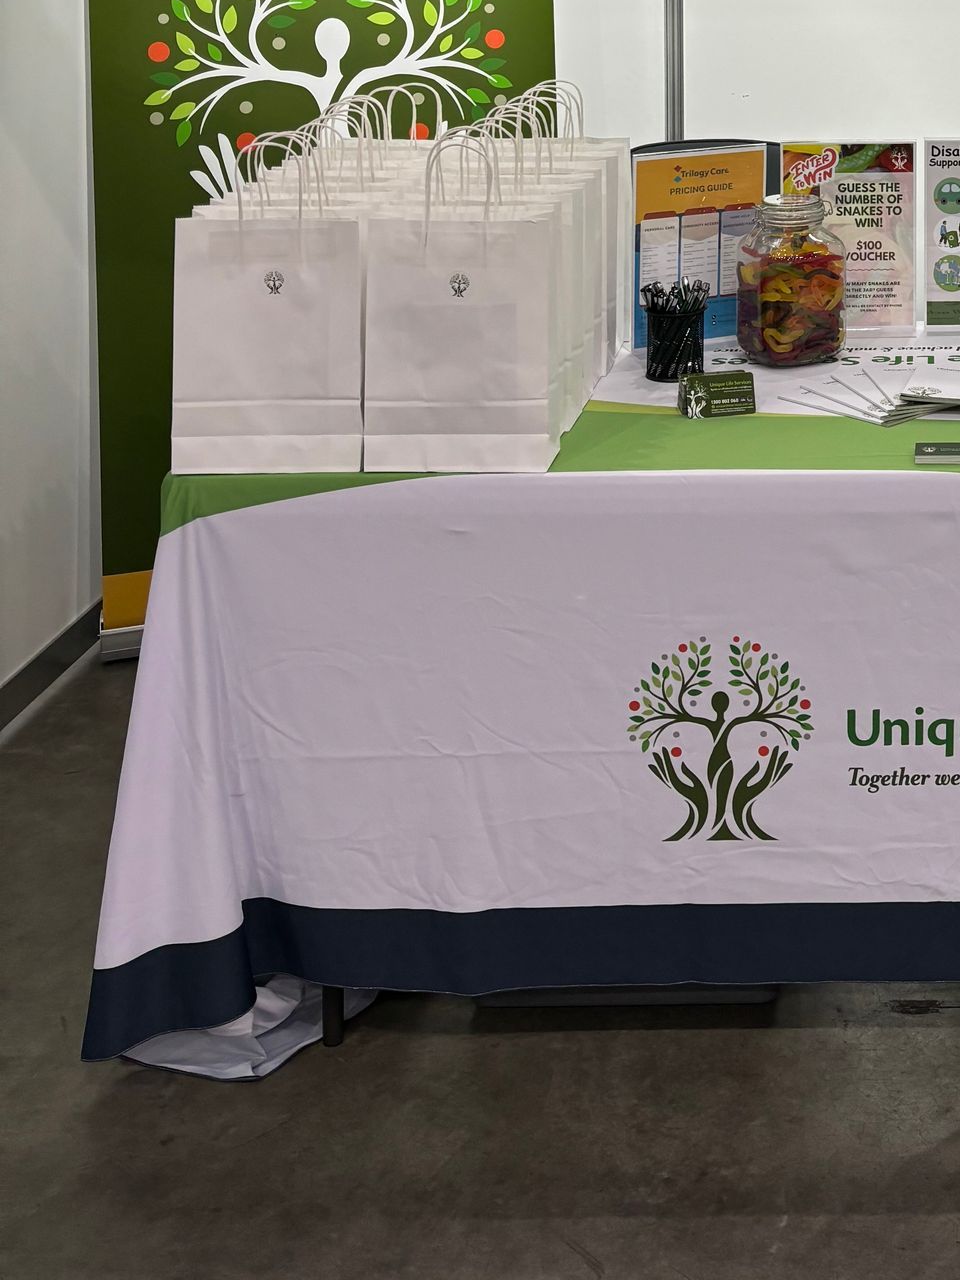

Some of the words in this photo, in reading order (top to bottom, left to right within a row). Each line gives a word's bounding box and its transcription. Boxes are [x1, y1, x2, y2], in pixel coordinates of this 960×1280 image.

[681, 169, 709, 178] Trilogy
[710, 167, 729, 176] Care
[791, 154, 829, 180] ENTER
[669, 185, 705, 195] PRICING
[707, 182, 733, 192] GUIDE
[837, 182, 876, 193] GUESS
[879, 183, 900, 192] THE
[835, 194, 884, 204] NUMBER
[886, 194, 903, 204] OF
[836, 206, 883, 216] SNAKES
[887, 205, 902, 215] TO
[854, 218, 883, 227] WIN!
[856, 240, 882, 251] $100
[871, 355, 935, 365] Life
[848, 766, 931, 793] Together
[934, 772, 960, 786] we
